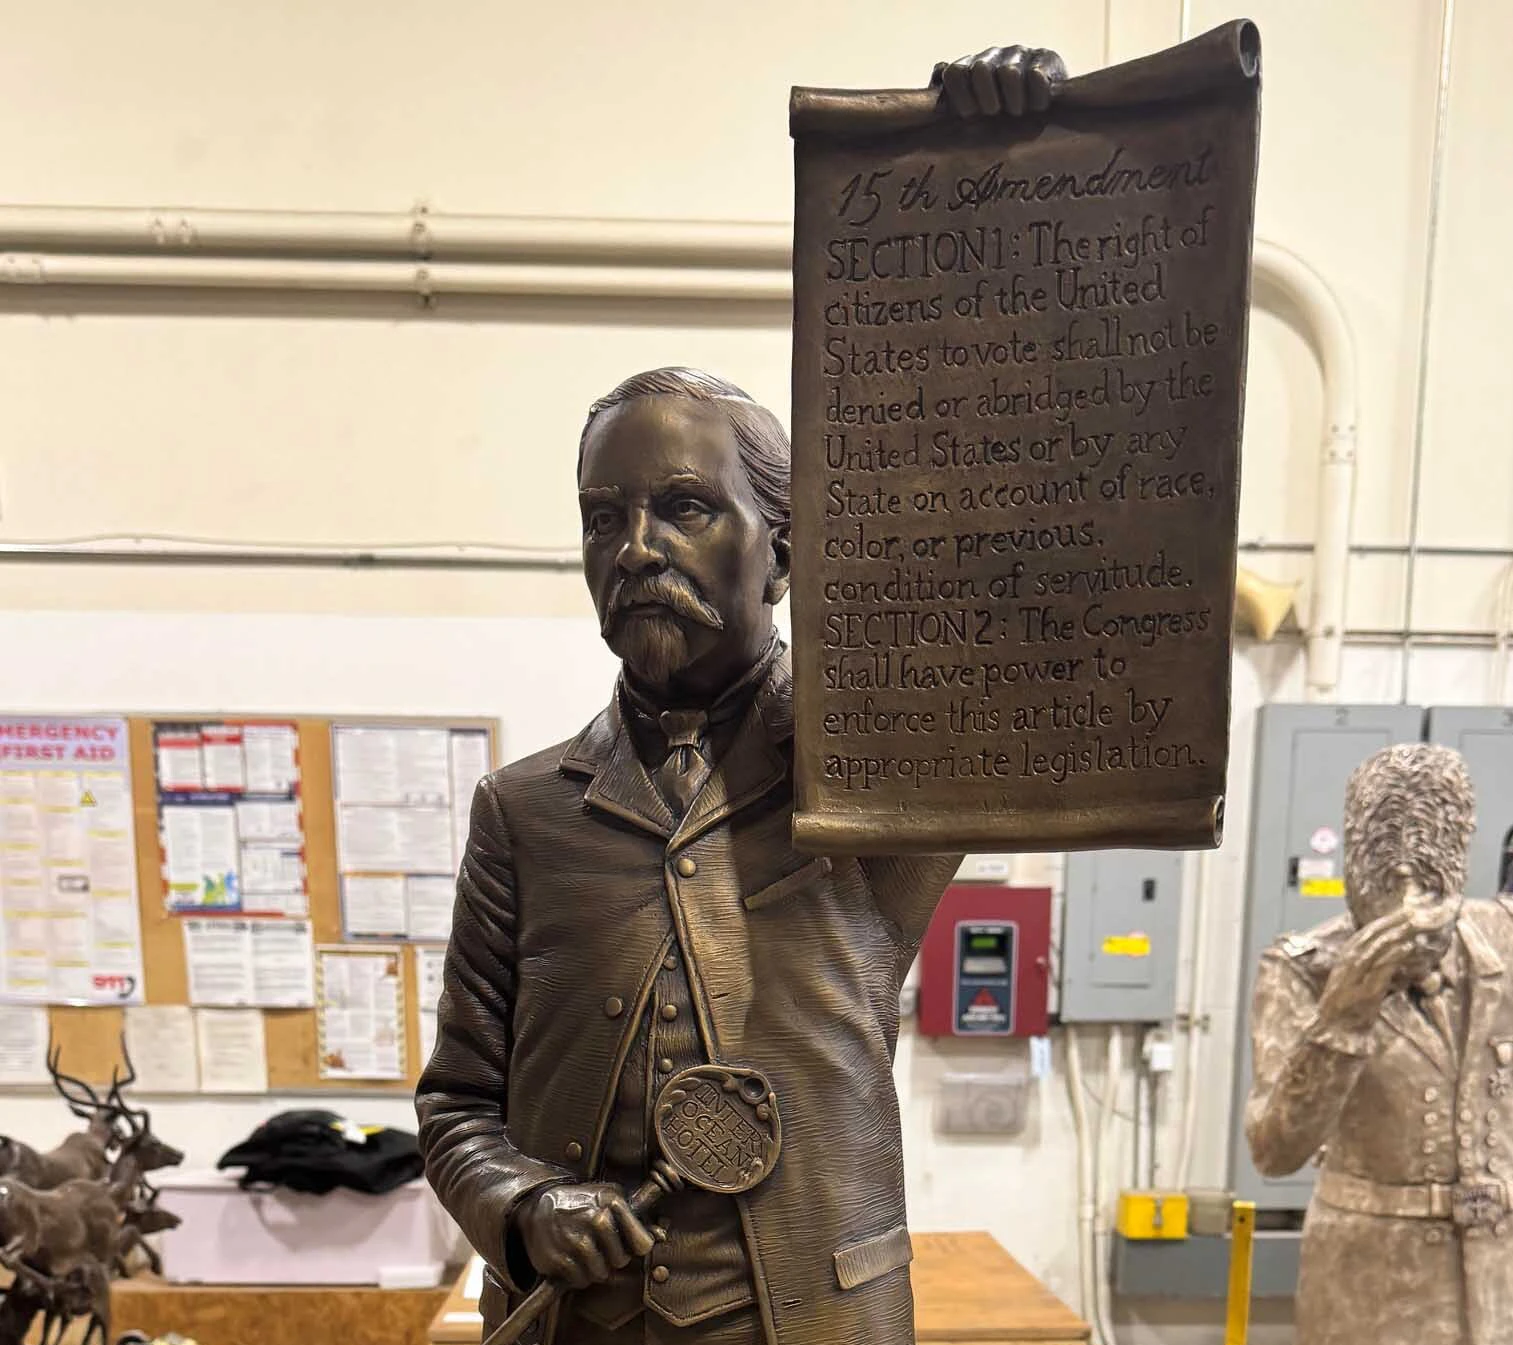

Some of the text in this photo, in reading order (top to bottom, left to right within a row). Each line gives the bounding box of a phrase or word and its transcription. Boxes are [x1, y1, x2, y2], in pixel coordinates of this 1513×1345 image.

[838, 147, 1211, 227] 15 th Amendment
[1027, 222, 1090, 266] The
[1097, 214, 1172, 270] right
[1179, 207, 1214, 247] of
[824, 262, 1167, 326] citizens of the United
[824, 313, 1218, 377] States to vote shall not be
[825, 362, 1214, 424] denied or abridged by the
[824, 422, 1188, 471] United States or by any
[826, 479, 902, 518] State
[913, 491, 947, 512] on
[960, 473, 1088, 509] account
[1101, 464, 1132, 500] of
[913, 537, 946, 558] or
[824, 551, 1193, 602] condition of servitude.
[1018, 606, 1073, 644] The
[1082, 605, 1210, 647] Congress
[824, 650, 1126, 697] shall have power to
[0, 724, 118, 741] MERGENCY
[823, 689, 1173, 736] enforce this article by
[2, 744, 115, 761] FIRST AID
[823, 747, 1009, 790] appropriate
[682, 1099, 753, 1168] OCEAN
[695, 1083, 765, 1154] INTER
[663, 1114, 728, 1184] HOTEL
